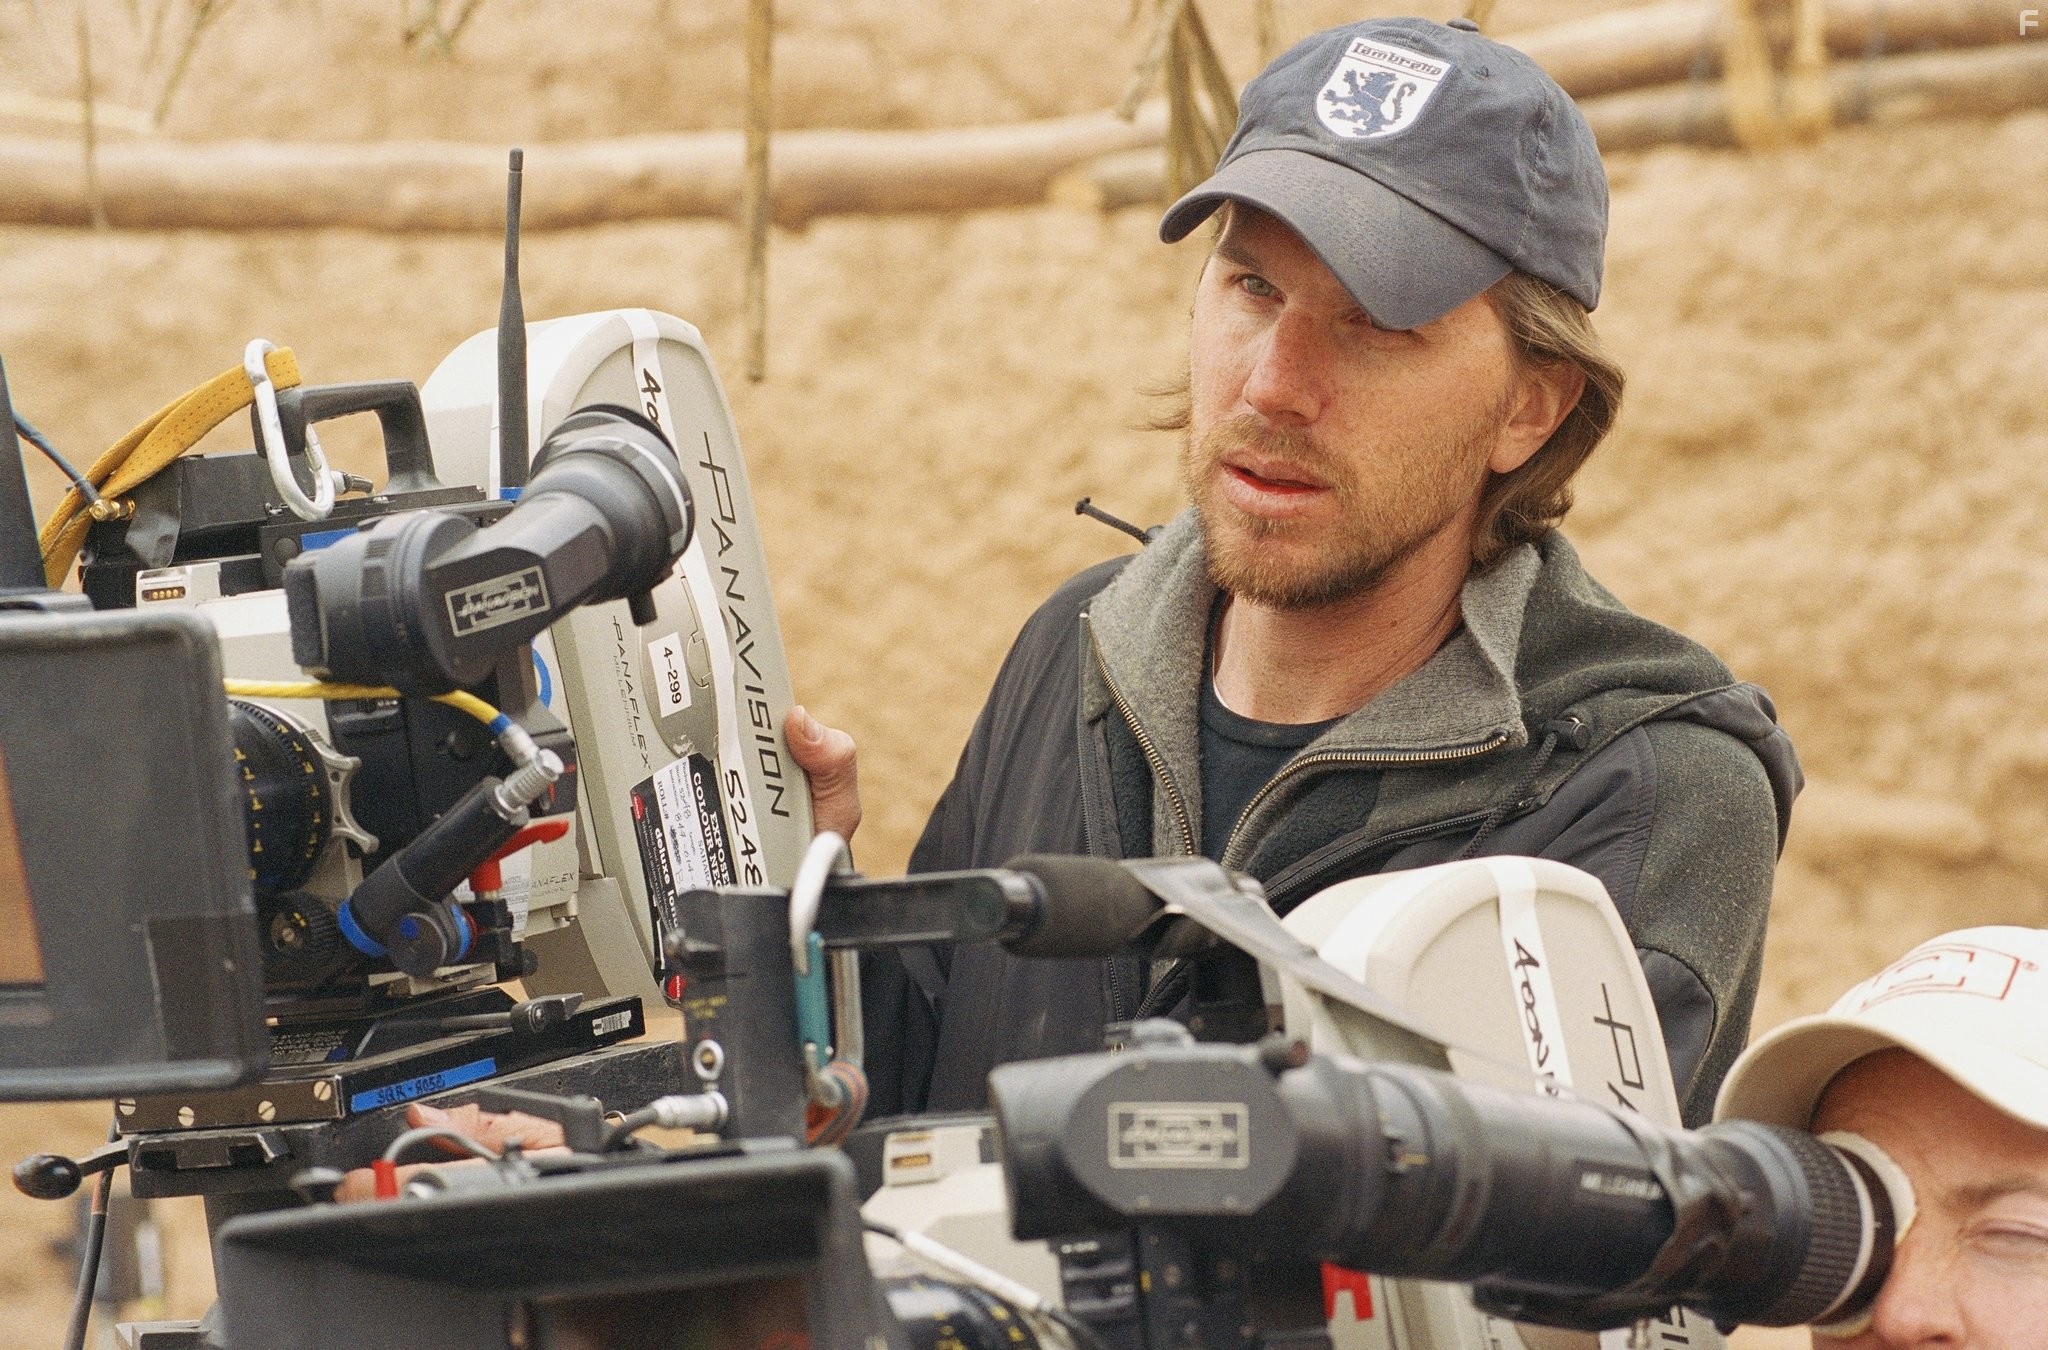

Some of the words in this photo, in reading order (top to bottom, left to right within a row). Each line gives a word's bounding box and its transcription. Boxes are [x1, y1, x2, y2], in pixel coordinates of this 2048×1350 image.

[641, 368, 662, 424] 40
[700, 431, 790, 818] PANAVISION
[613, 615, 651, 770] PANAFLEX
[663, 646, 682, 705] 4-299
[692, 772, 715, 852] COLOUR
[709, 812, 730, 887] EXPOSE
[724, 768, 763, 887] 5248
[531, 871, 575, 890] ANAFLEX
[654, 827, 672, 885] deluxe
